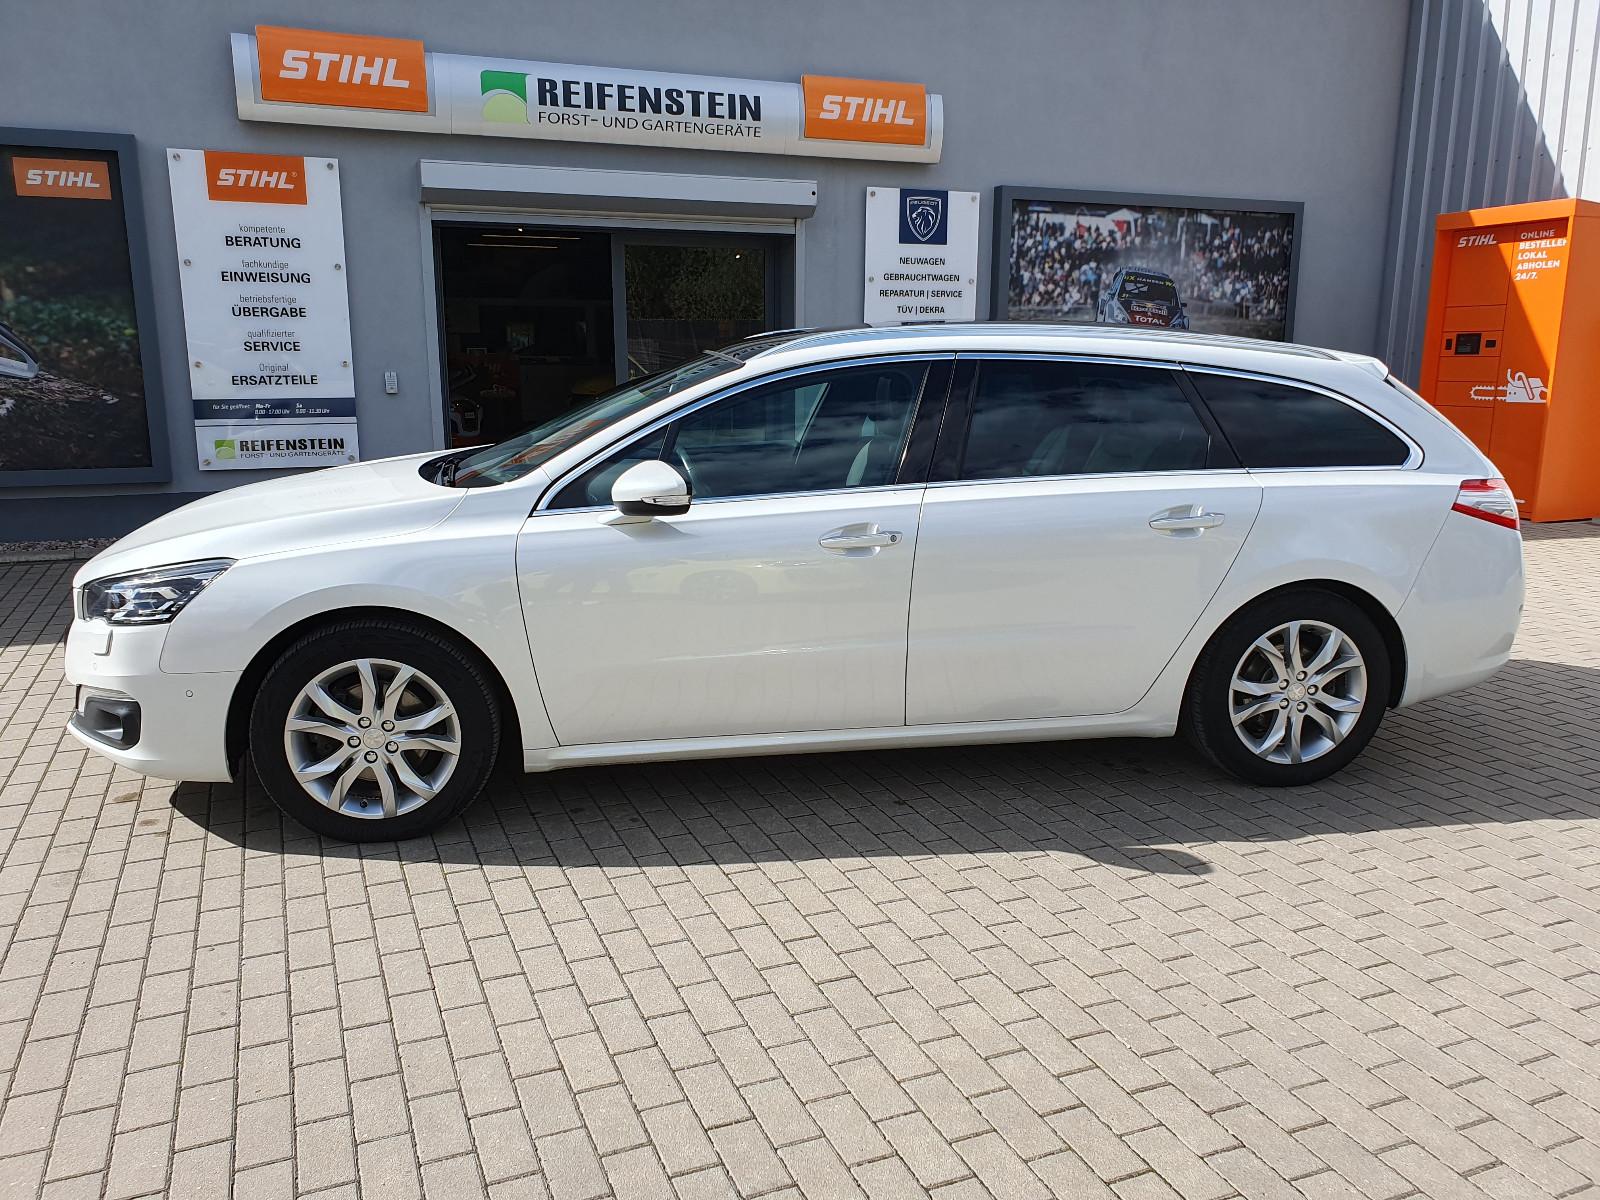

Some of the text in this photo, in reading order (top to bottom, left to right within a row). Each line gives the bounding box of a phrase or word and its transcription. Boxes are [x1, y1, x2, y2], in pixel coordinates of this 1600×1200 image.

[279, 49, 410, 88] STIHL
[537, 77, 761, 122] REIFENSTEIN
[819, 94, 915, 126] STIHL
[538, 111, 762, 138] FORST- UND GARTENGERÄTE
[26, 169, 100, 188] STIHL
[239, 224, 286, 234] kompetente
[1520, 229, 1556, 240] ONLINE
[225, 235, 301, 249] BERATUNG
[1457, 233, 1497, 248] STIHL
[1518, 250, 1548, 260] LOKAL
[242, 259, 289, 270] fachkundige
[899, 257, 945, 266] NEUWAGEN
[1517, 259, 1560, 270] ABHOLEN
[221, 271, 311, 284] EINWEISUNG
[883, 273, 960, 282] GEBRAUCHTWAGEN
[879, 289, 925, 298] REPARATUR
[240, 294, 297, 305] betriebsfertige
[231, 304, 307, 318] ÜBERGABE
[897, 304, 914, 314] TÜV
[919, 306, 945, 314] DEKRA
[1135, 316, 1165, 325] TOTAL
[247, 329, 296, 339] qualifizierter
[243, 341, 301, 352] SERVICE
[259, 363, 289, 373] Original
[231, 374, 319, 385] ERSATZTEILE
[239, 438, 345, 451] REIFENSTEIN
[287, 450, 345, 458] GARTENGERÄTE
